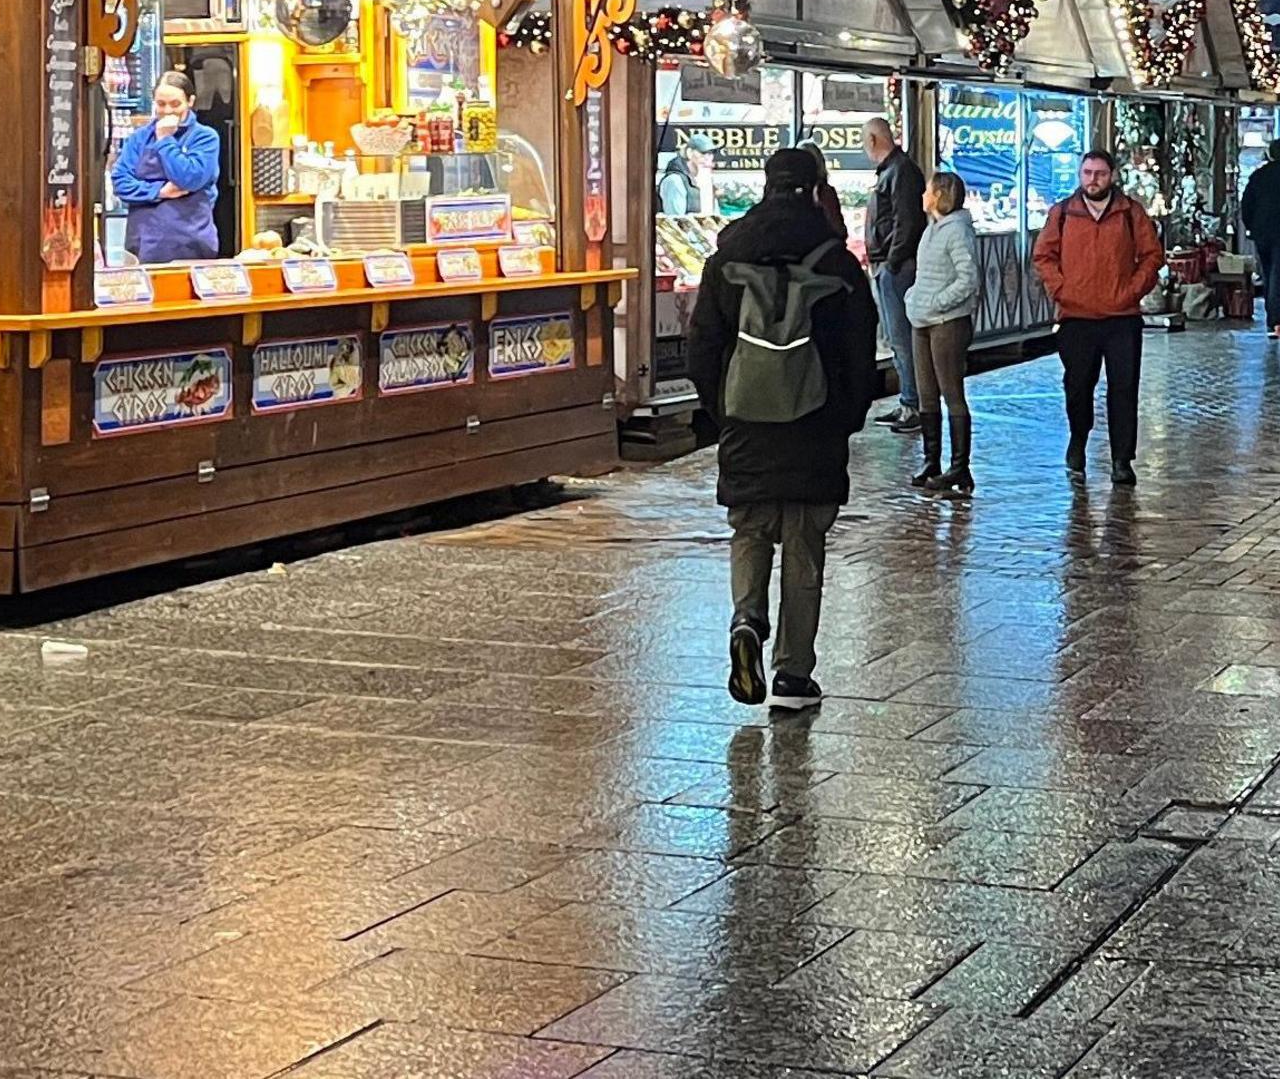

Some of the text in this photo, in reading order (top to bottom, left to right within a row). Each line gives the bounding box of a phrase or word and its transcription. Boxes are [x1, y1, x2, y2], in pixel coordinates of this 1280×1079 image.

[258, 341, 329, 373] HALLOUMI
[390, 333, 438, 358] CHICKEN
[104, 357, 176, 393] CHICKEN
[270, 371, 317, 401] GYROS
[379, 357, 420, 386] SALAD
[110, 388, 168, 424] GYROS
